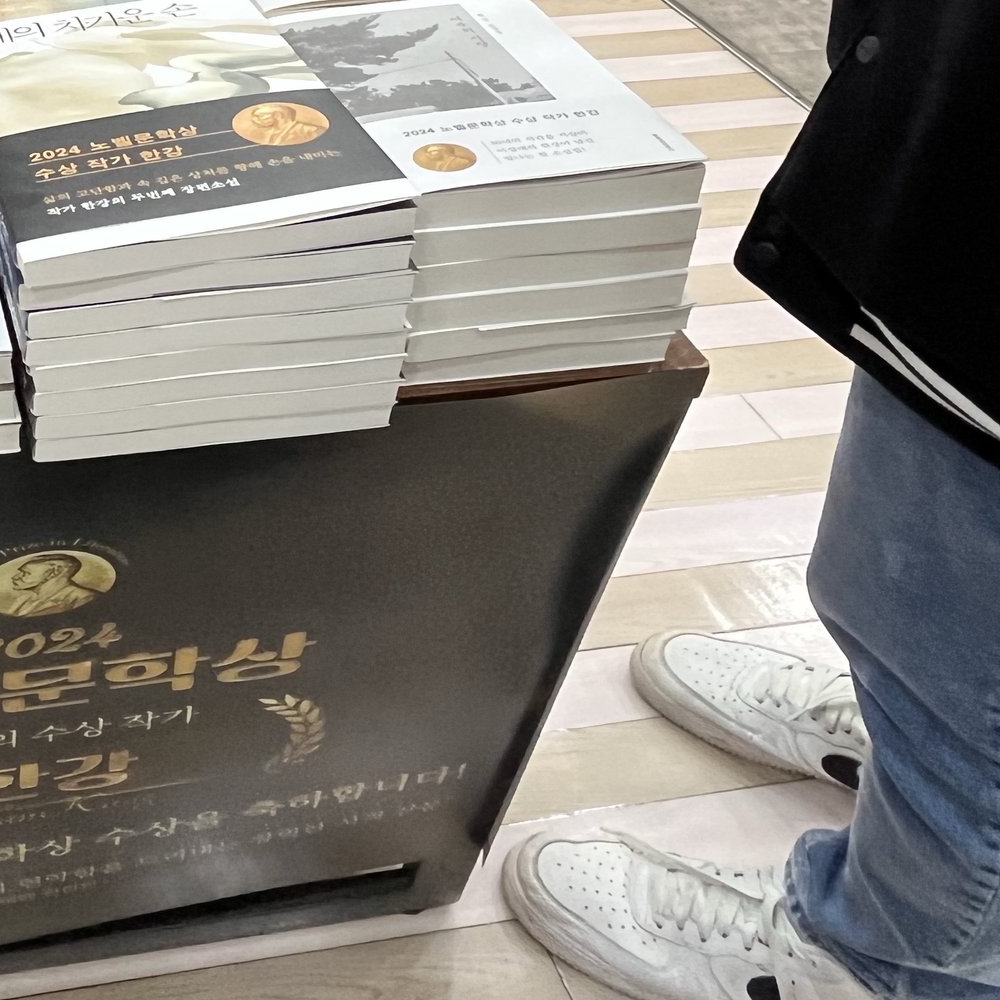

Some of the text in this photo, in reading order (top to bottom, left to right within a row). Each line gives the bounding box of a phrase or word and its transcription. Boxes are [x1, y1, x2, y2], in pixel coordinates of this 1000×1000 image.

[54, 7, 153, 32] 차가운
[161, 2, 199, 18] 손
[29, 124, 199, 163] 2024 노벨문학상
[403, 127, 435, 138] 2024
[34, 144, 184, 180] 수상 작가 한강
[31, 715, 112, 744] 수상
[120, 704, 200, 732] 작가
